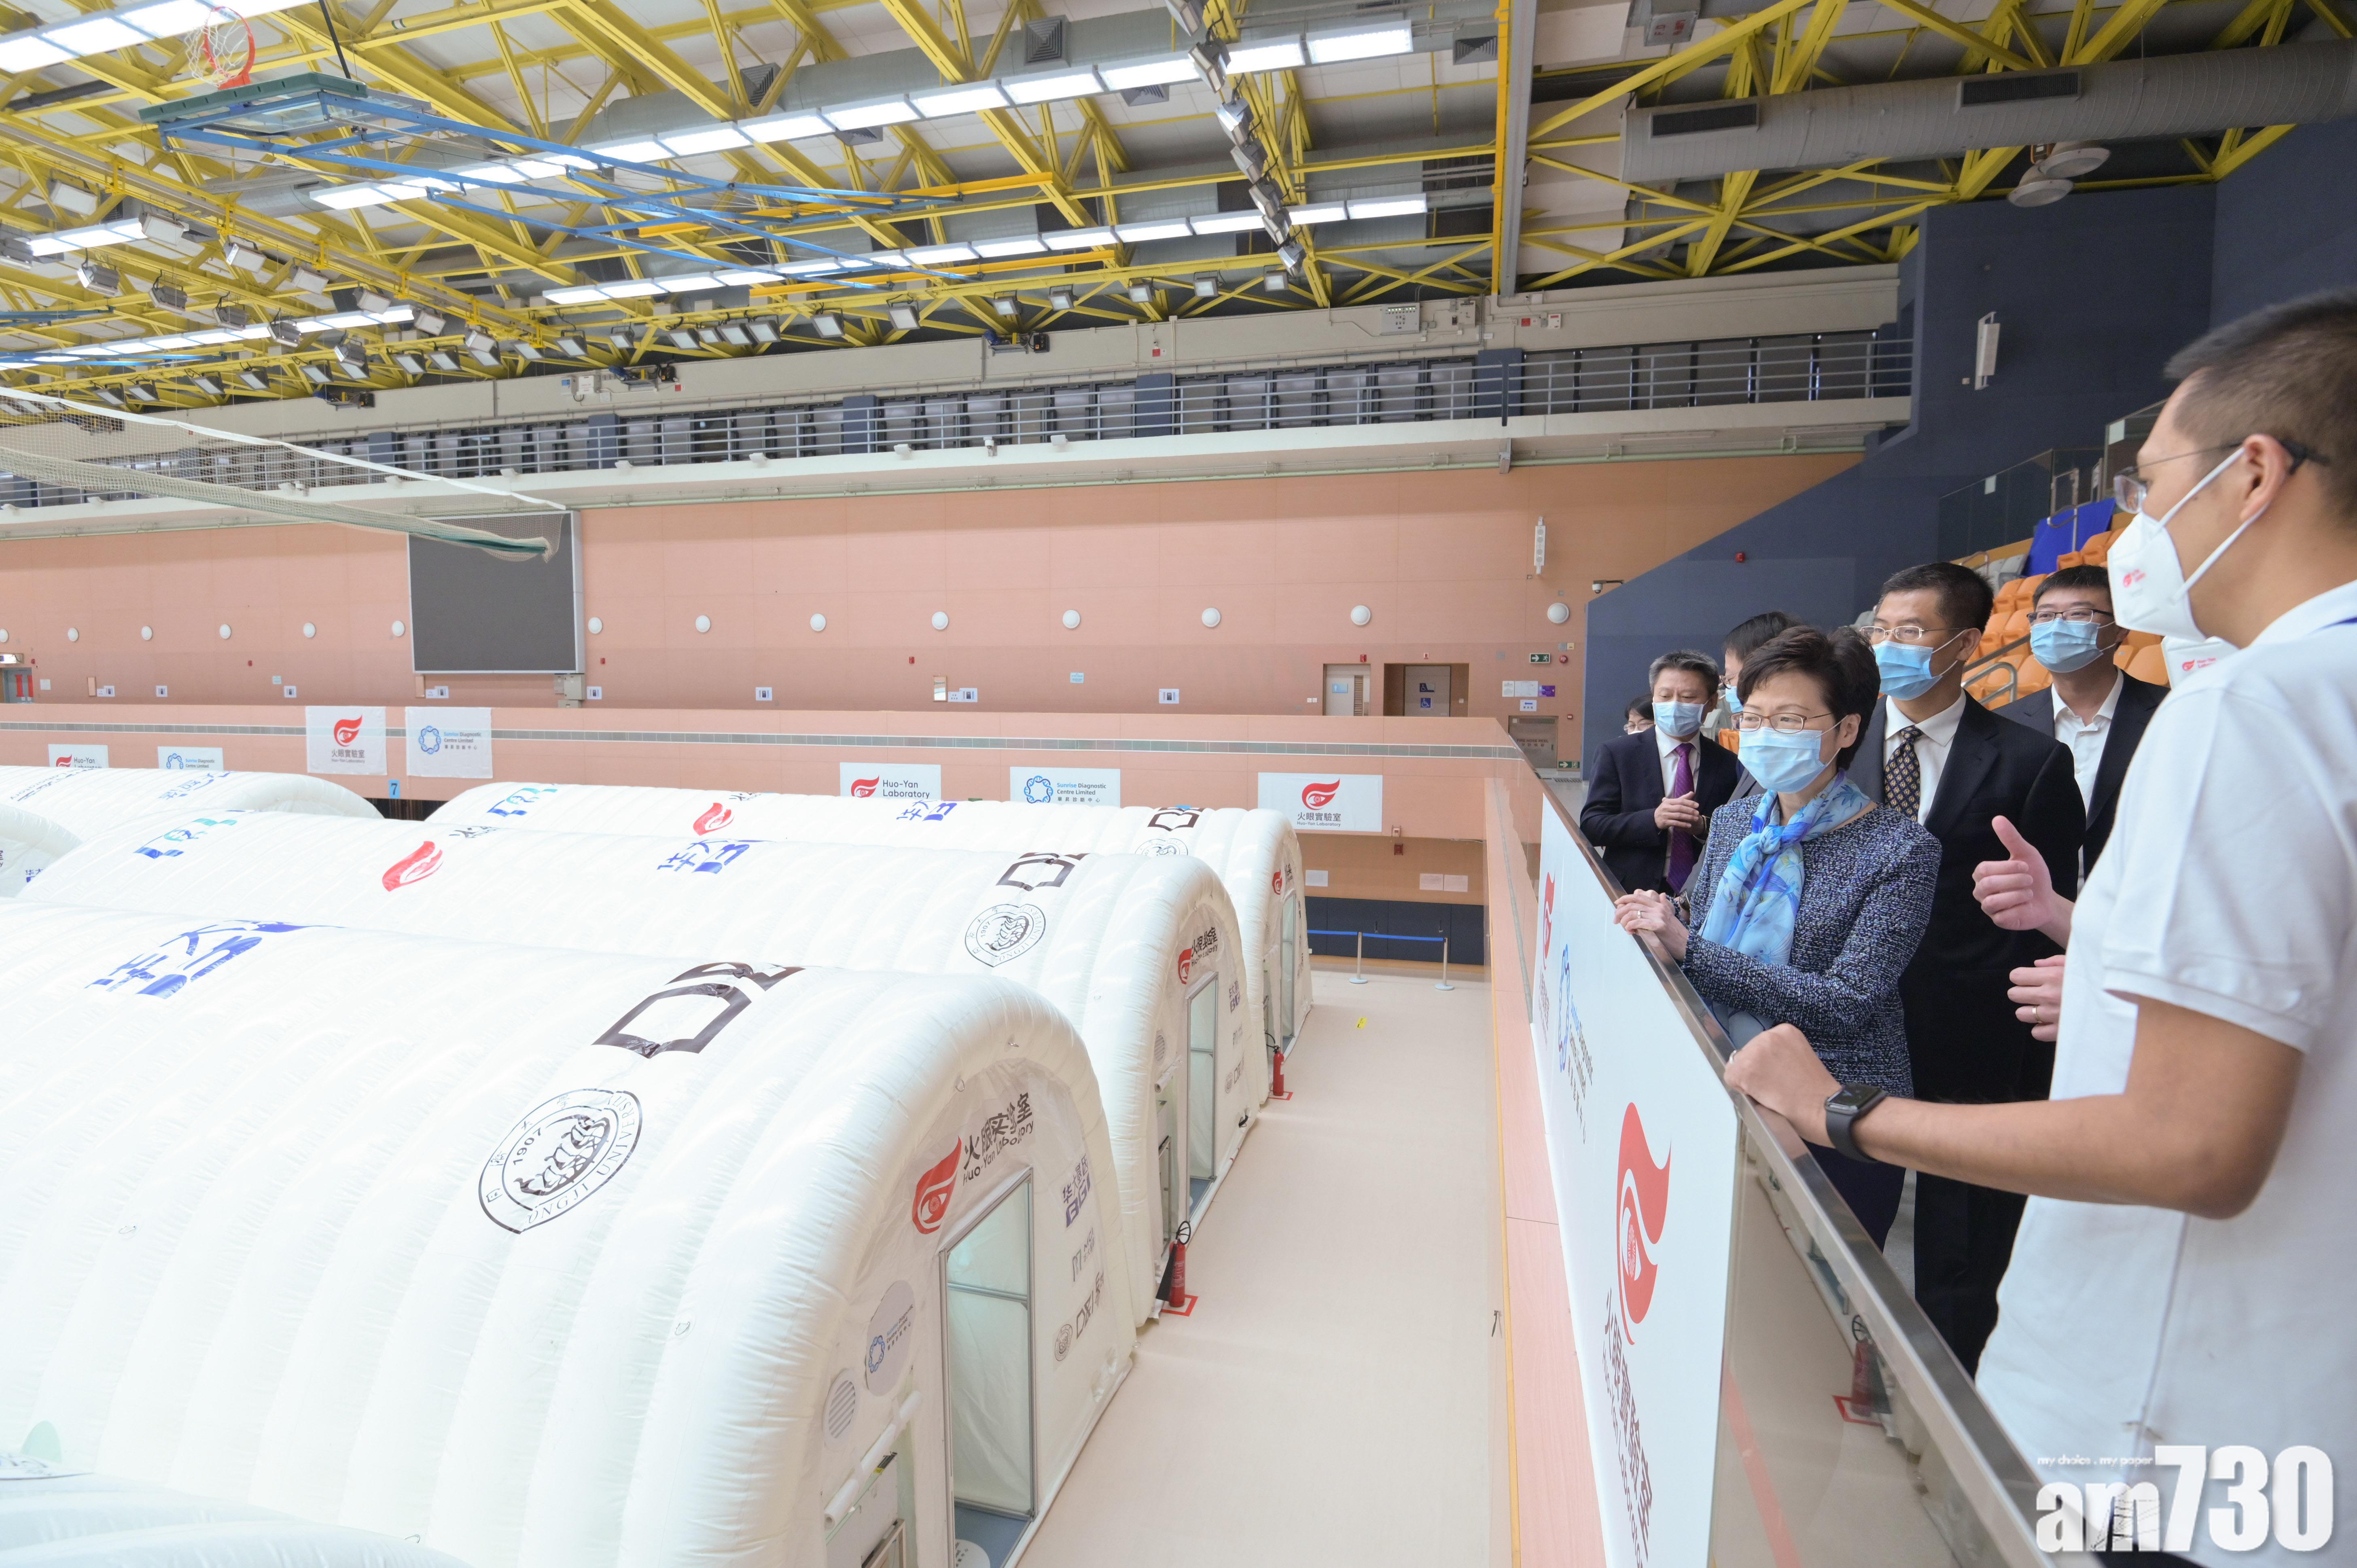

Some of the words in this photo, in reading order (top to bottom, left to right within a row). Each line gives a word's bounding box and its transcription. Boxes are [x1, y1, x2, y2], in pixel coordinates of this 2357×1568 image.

[331, 749, 365, 759] 火眼實驗室
[391, 783, 398, 795] 7
[883, 780, 918, 788] Huo-Yan
[883, 789, 930, 799] Laboratory
[1297, 812, 1342, 822] 火眼實驗室
[513, 1127, 543, 1165] 1907
[527, 1183, 589, 1224] ONGJI
[596, 1095, 635, 1176] UNIVERSIT
[963, 1151, 995, 1187] Huo-Yan
[1066, 1172, 1091, 1229] BGI
[1602, 1340, 1618, 1445] Huo-Yan
[1605, 1287, 1653, 1562] 火眼實驗室
